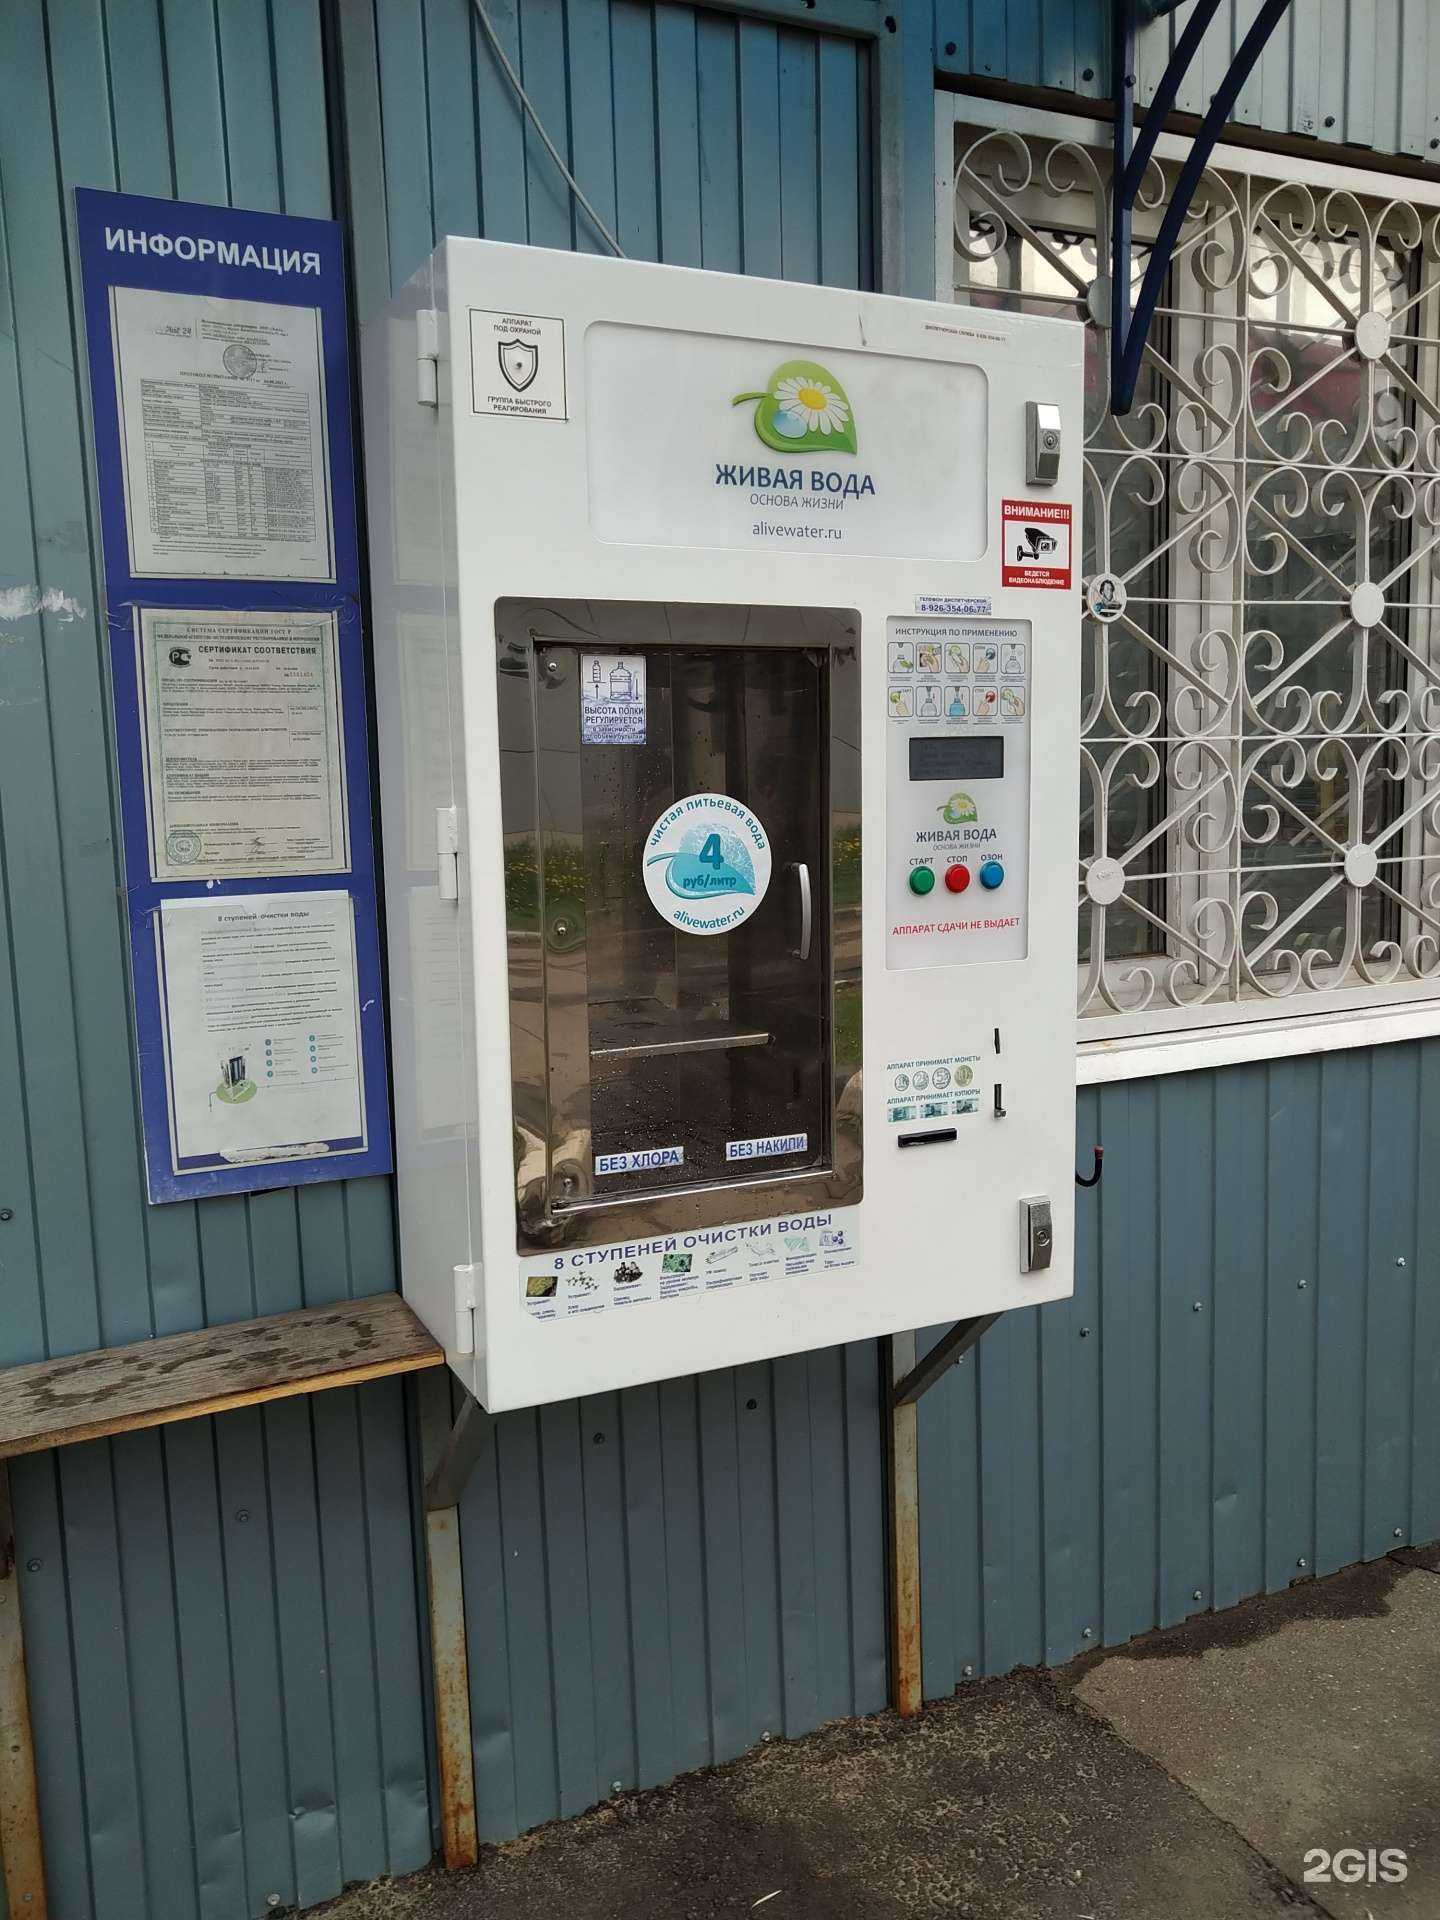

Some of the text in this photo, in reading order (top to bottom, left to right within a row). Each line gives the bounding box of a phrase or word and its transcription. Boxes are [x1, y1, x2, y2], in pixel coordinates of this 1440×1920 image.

[105, 226, 321, 275] ИНФОРМАЦИЯ
[502, 318, 533, 326] АППАРАТ
[493, 325, 541, 336] ПОД ОХРАНОЙ
[487, 396, 551, 407] ГРУППА БЫСТРОГО
[493, 405, 547, 414] РЕАГИРОВАНИЯ
[715, 464, 876, 500] ЖИВАЯ ВОДА
[750, 493, 844, 510] ОСНОВА ЖИЗНИ
[1004, 505, 1070, 519] ВНИМАНИЕ!!!
[752, 521, 842, 540] alivewater.ru
[1008, 577, 1065, 586] ВИДЕОНАБЛЮДЕНИЕ
[895, 628, 947, 637] ИНСТРУКЦИЯ
[962, 629, 1017, 637] ПРИМЕНЕНИЮ
[198, 645, 317, 655] СЕРТИФИКАТ СООТВЕТСТВИЯ
[584, 706, 644, 715] ВЫСОТА ПОЛКИ
[586, 716, 643, 724] РЕГУЛИРУЕТСЯ
[650, 798, 765, 850] чистая питьевая вода
[916, 828, 997, 842] ЖИВАЯ ВОДА
[699, 833, 724, 870] 4
[980, 853, 1003, 861] ОЗОН
[909, 857, 934, 866] СТАРТ
[946, 855, 968, 863] СТОП
[683, 874, 737, 889] руб/литр
[673, 906, 745, 929] alivewater.ru
[892, 917, 1020, 936] АППАРАТ СДАЧИ НЕ ВЫДАЕТ
[887, 1055, 981, 1071] АППАРАТ ПРИНИМАЕТ МОНЕТЫ
[887, 1089, 981, 1105] АППАРАТ ПРИНИМАЕТ КУПЮРЫ
[729, 1136, 804, 1158] БЕЗ НАКИПИ
[600, 1149, 679, 1172] БЕЗ ХЛОРА
[554, 1214, 832, 1270] 8 СТУПЕНЕЙ ОЧИСТКИ ВОДЫ
